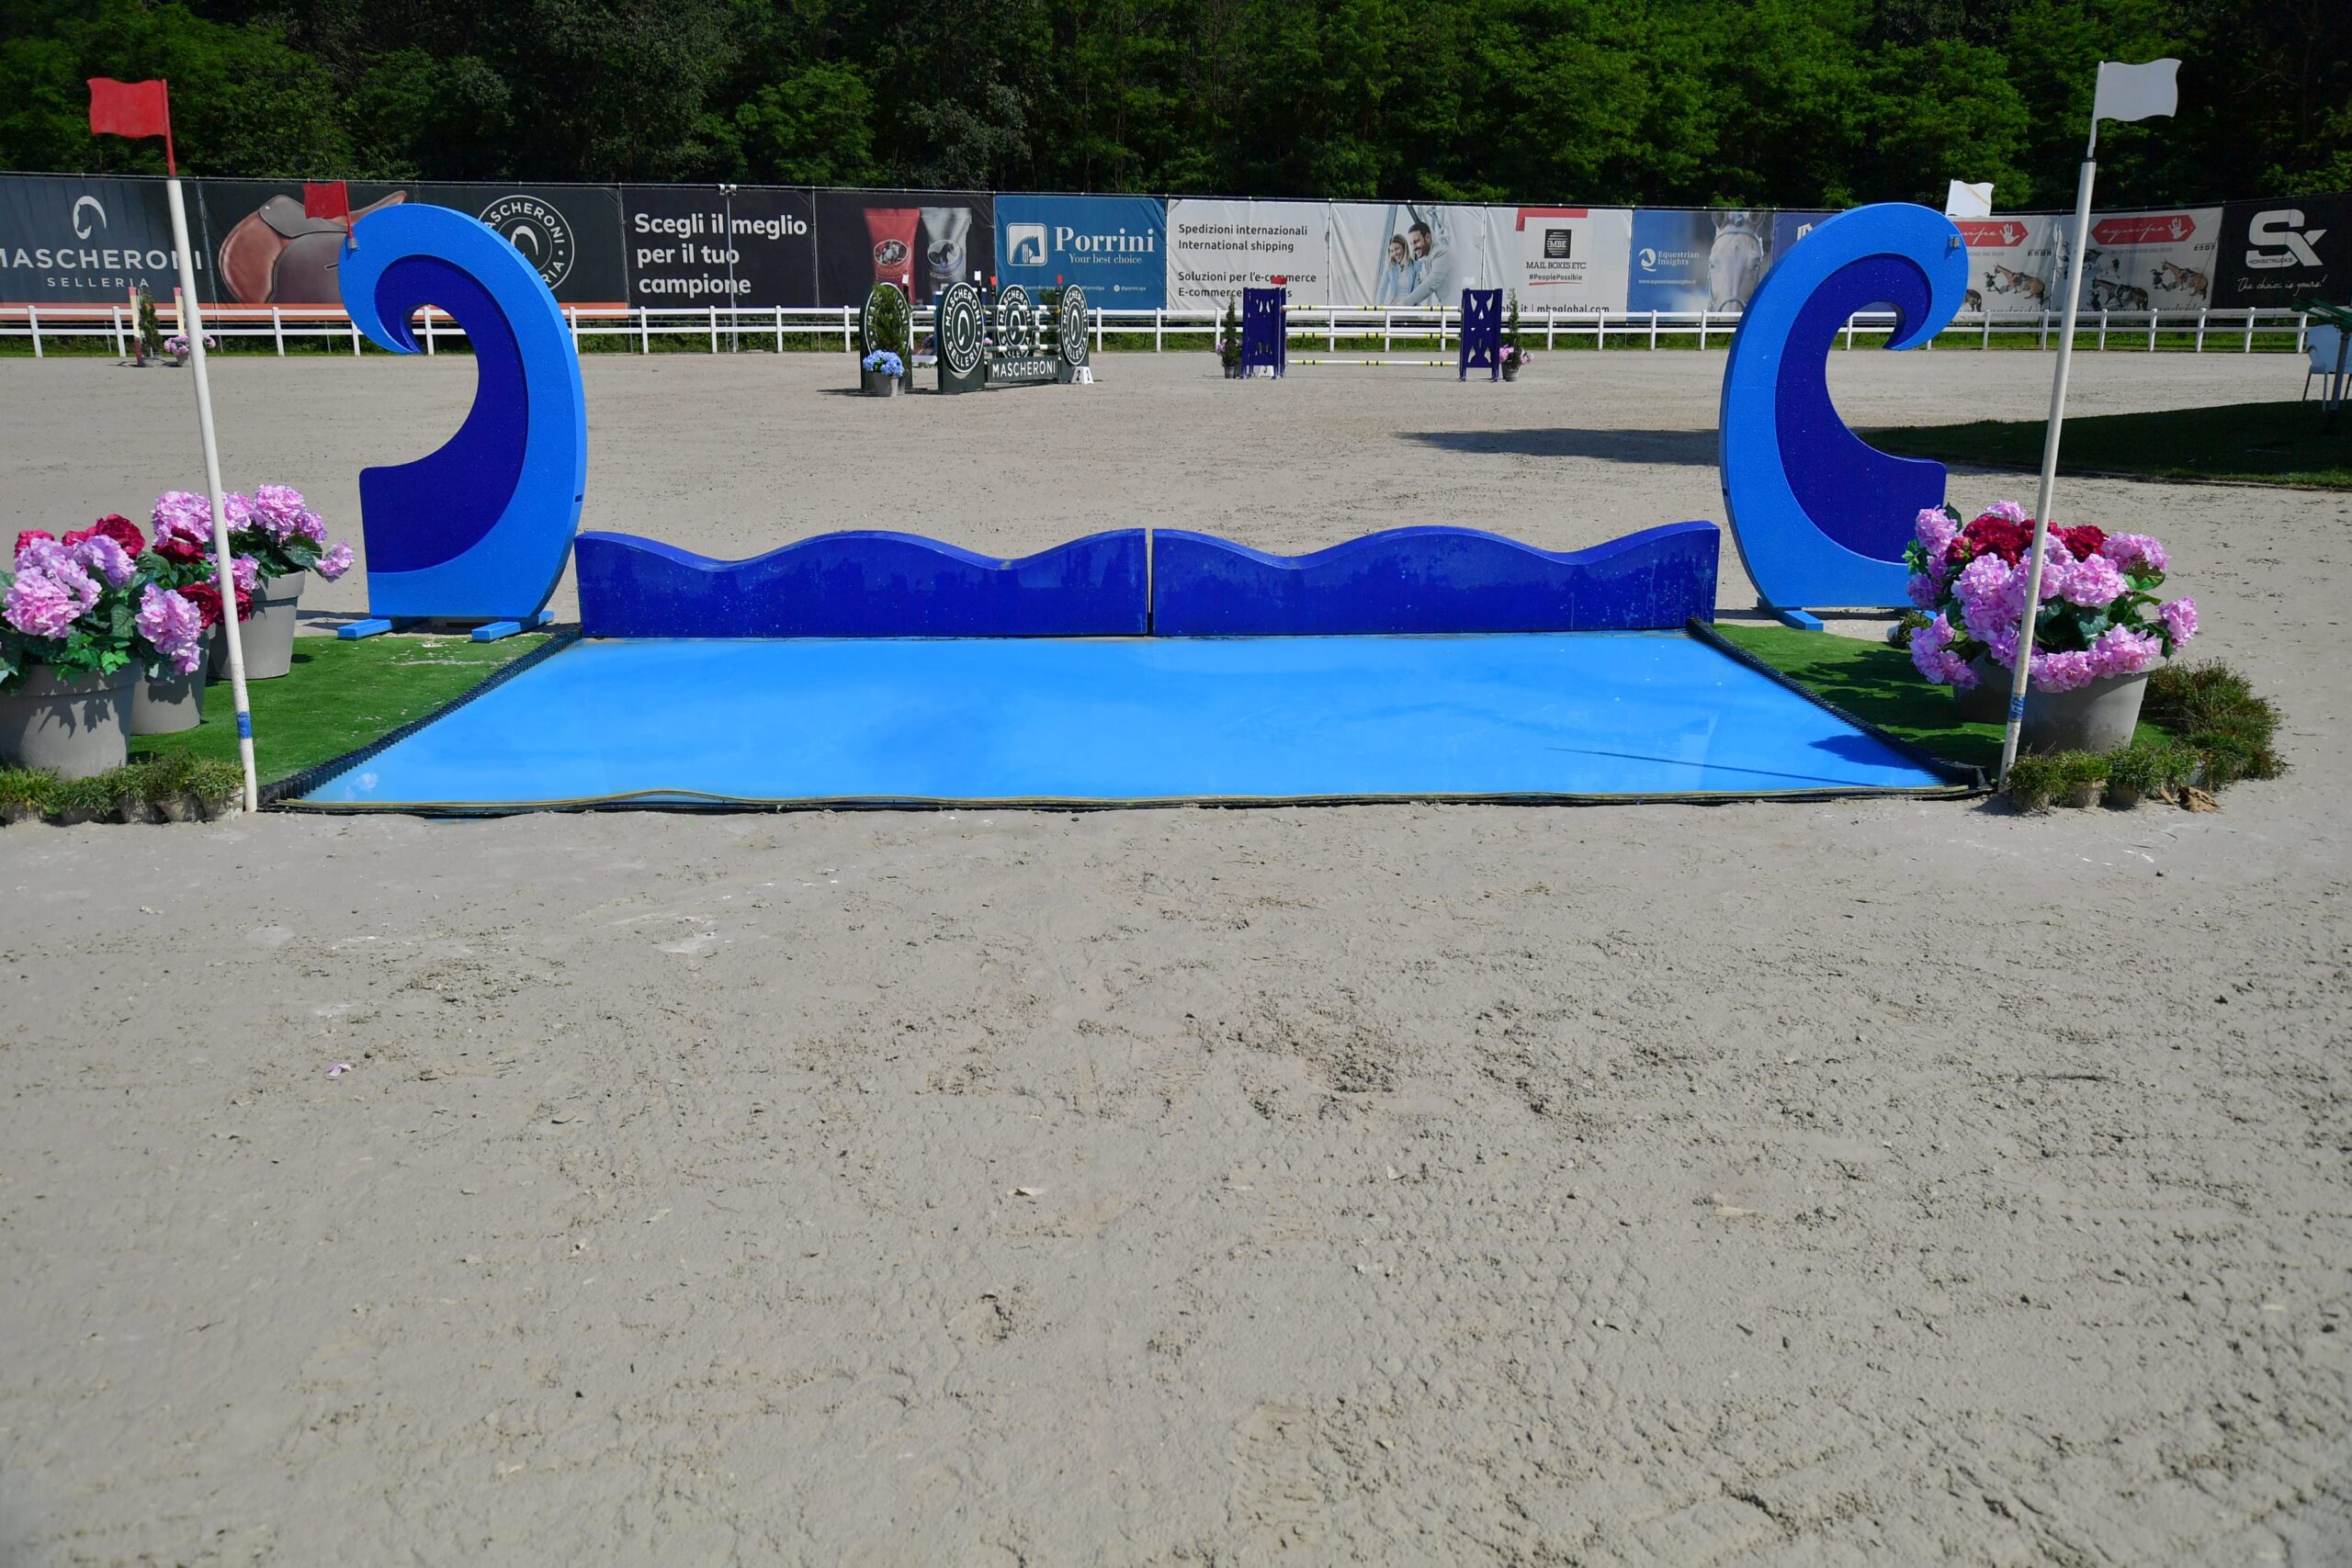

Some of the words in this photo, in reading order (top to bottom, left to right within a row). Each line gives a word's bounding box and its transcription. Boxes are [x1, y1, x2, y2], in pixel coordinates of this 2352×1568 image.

[484, 202, 565, 243] ASCHERONI
[634, 212, 705, 239] Scegli
[711, 213, 724, 233] il
[731, 214, 808, 240] meglio
[1179, 223, 1234, 237] Spedizioni
[1236, 224, 1308, 236] internazionali
[1055, 226, 1155, 253] Porrini
[2101, 223, 2167, 243] equipe
[1179, 241, 1249, 251] International
[1251, 242, 1294, 253] shipping
[1550, 240, 1567, 248] MBE
[637, 248, 675, 268] per
[682, 243, 695, 264] il
[701, 245, 740, 265] tuo
[1069, 254, 1091, 264] Your
[1092, 254, 1111, 264] best
[1114, 254, 1143, 265] choice
[1657, 251, 1700, 259] Equestrian
[1657, 258, 1690, 267] Insights
[47, 277, 150, 288] SELLERIA
[639, 273, 752, 299] campione
[1178, 272, 1227, 282] Soluzioni
[1229, 274, 1248, 284] per
[2237, 277, 2254, 291] The
[2256, 277, 2282, 289] choice
[2285, 279, 2294, 288] is
[2293, 274, 2329, 297] yours!
[1179, 288, 1242, 298] E-commerce
[945, 288, 981, 327] MASCHERONI
[1063, 290, 1088, 323] MASCHERONI
[948, 341, 981, 367] SELLERIA
[1066, 337, 1087, 364] SELLERIA
[992, 361, 1056, 378] MASCHERONI
[1076, 369, 1081, 381] 2
